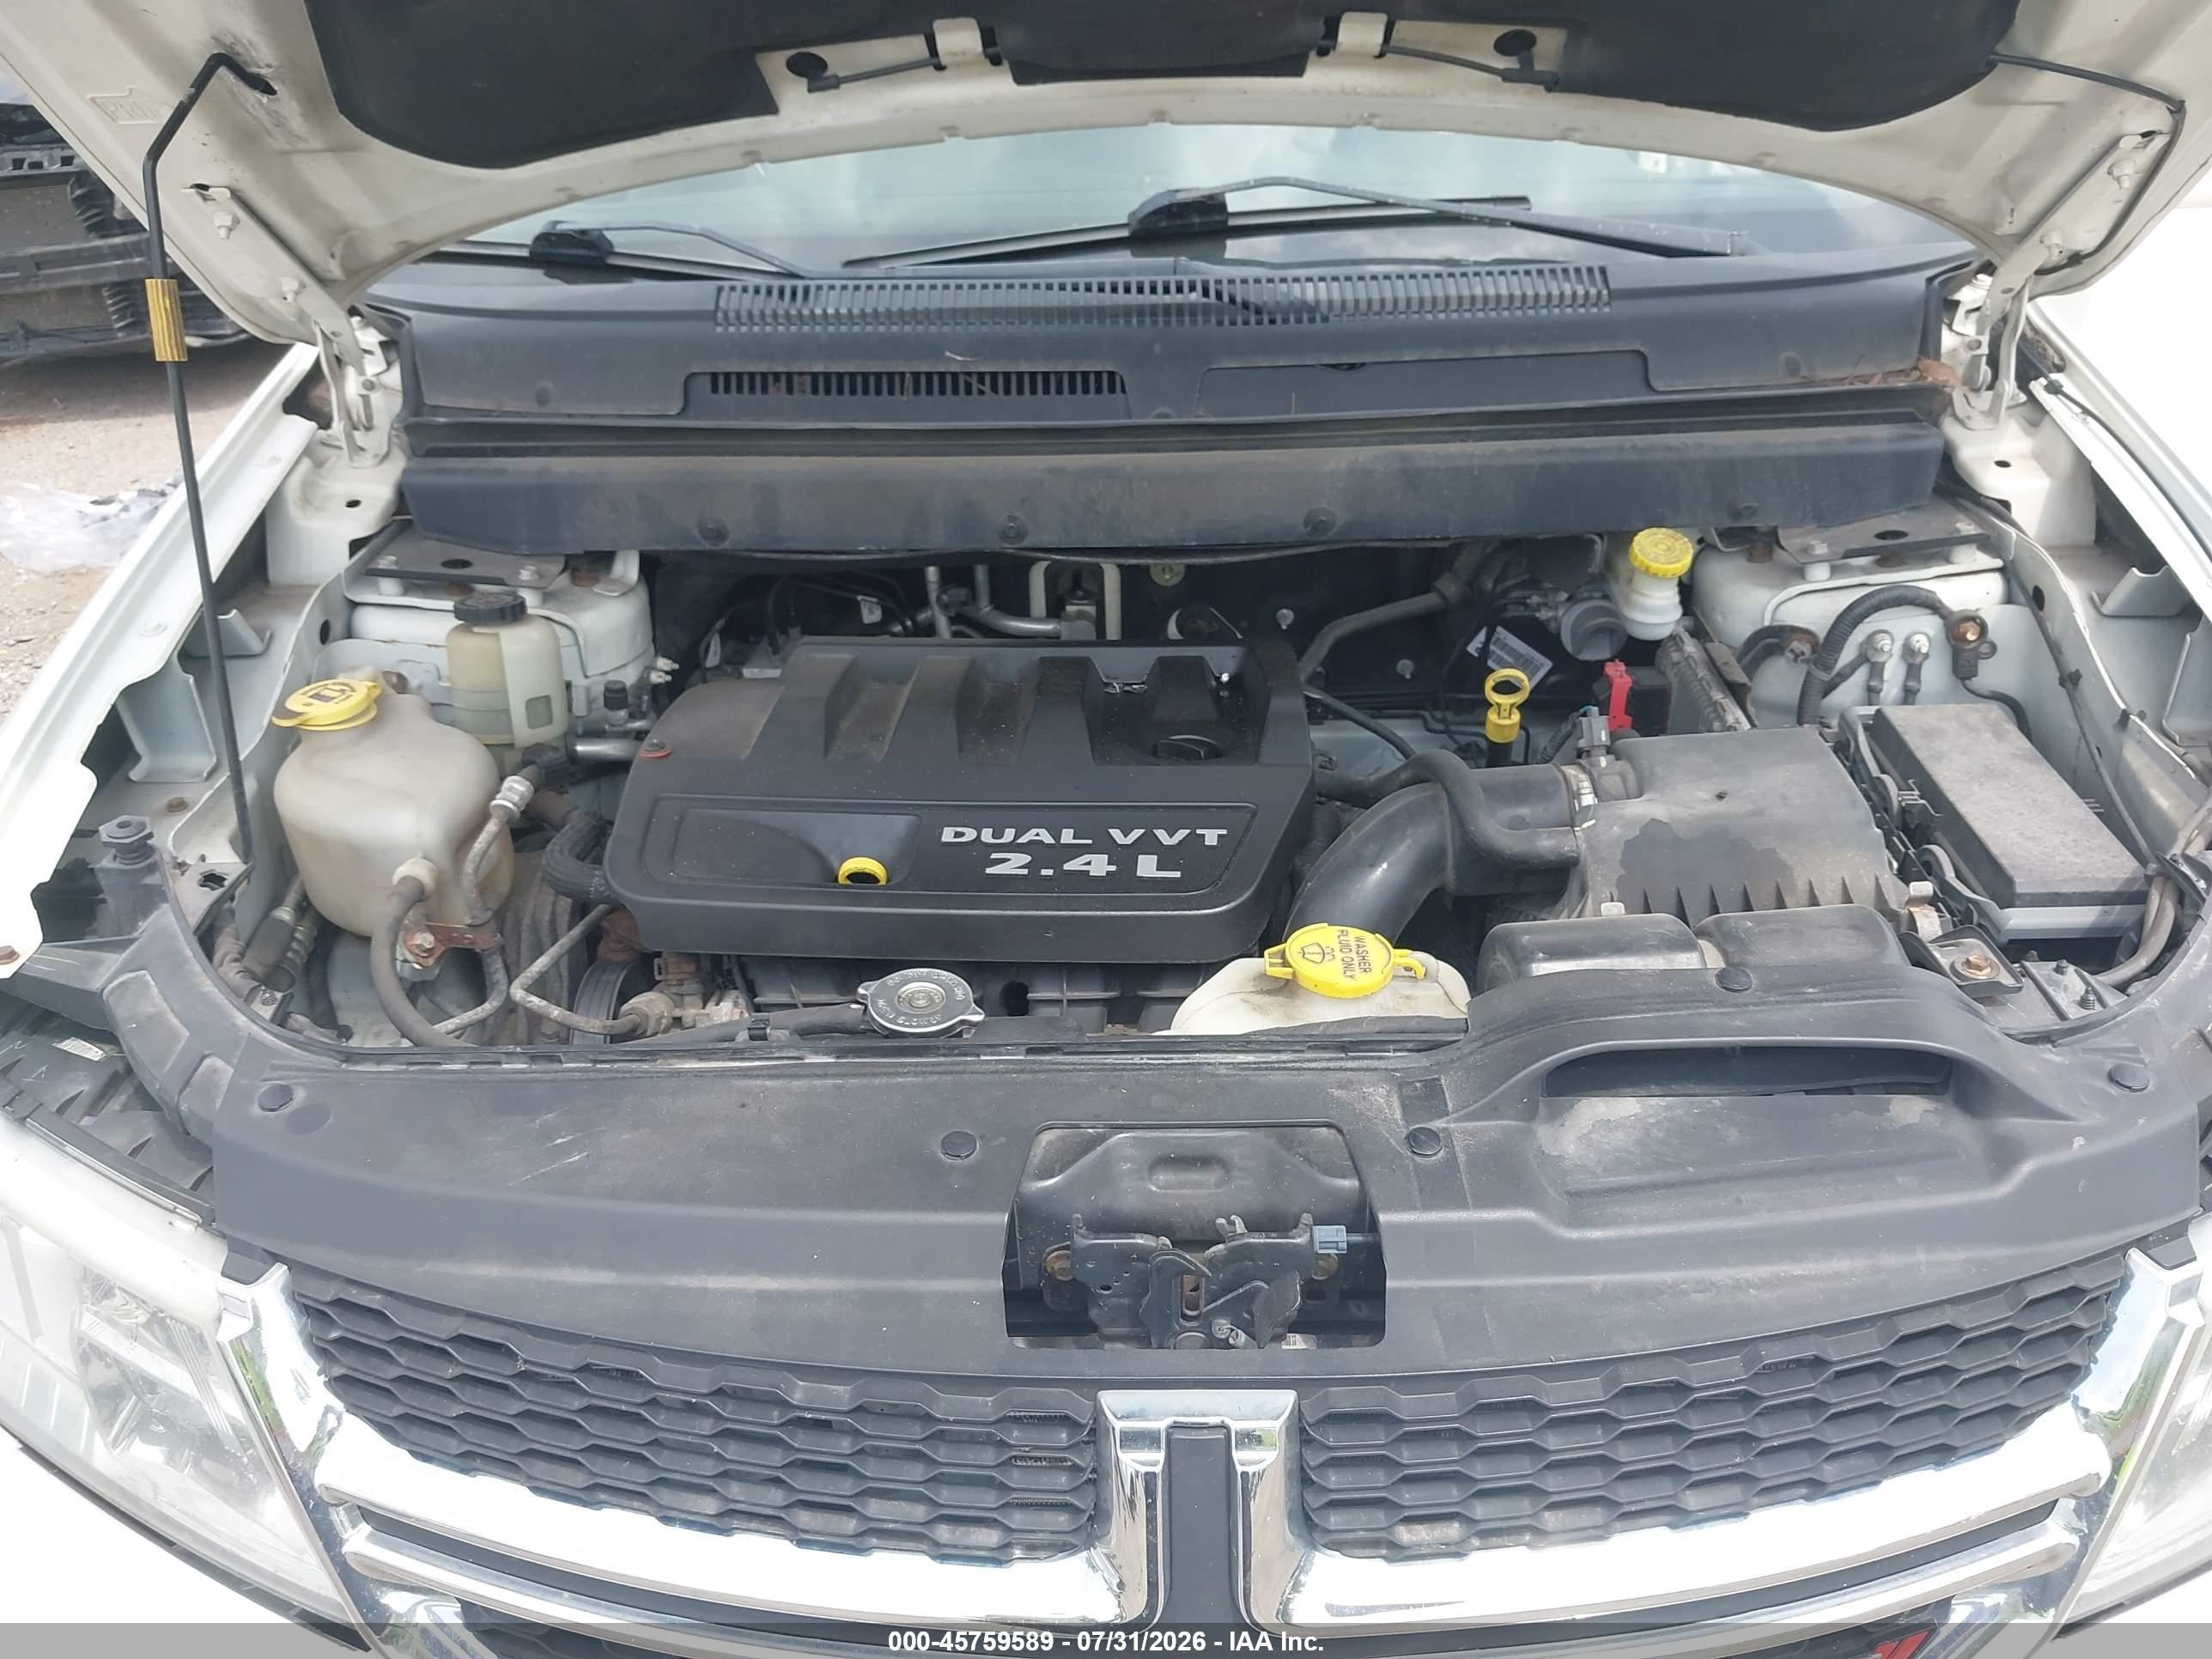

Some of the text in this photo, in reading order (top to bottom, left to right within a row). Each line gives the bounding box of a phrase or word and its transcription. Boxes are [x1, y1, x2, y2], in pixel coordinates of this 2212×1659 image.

[940, 826, 1228, 846] DUAL VVT
[1337, 929, 1358, 980] FLUID ONLY
[1353, 936, 1372, 973] WASHER
